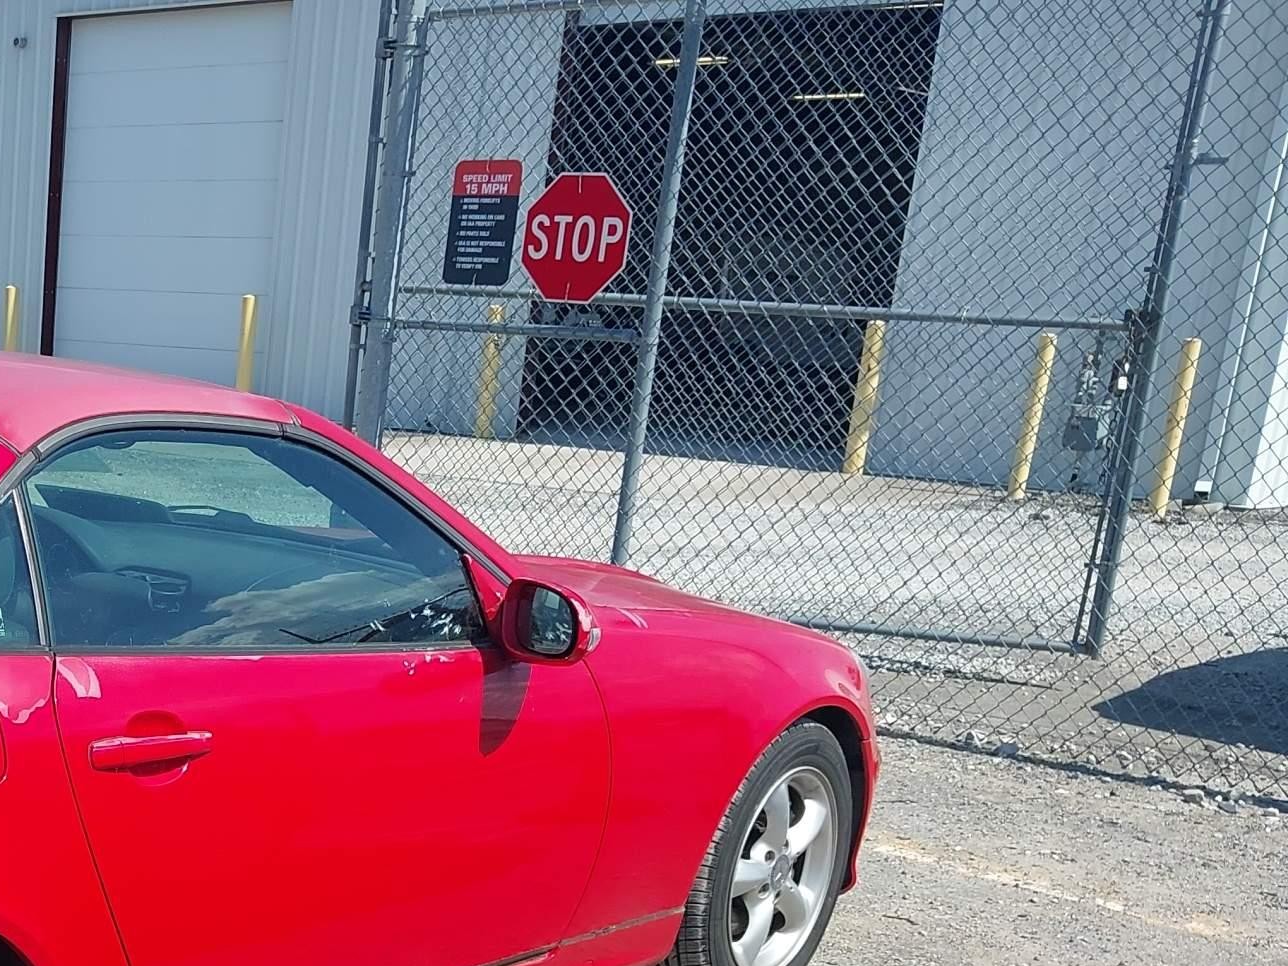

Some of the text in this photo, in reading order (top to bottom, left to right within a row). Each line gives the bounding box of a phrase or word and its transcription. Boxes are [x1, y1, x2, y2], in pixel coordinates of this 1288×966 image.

[462, 174, 513, 183] SPEED LIMIT
[465, 183, 508, 195] 15 MPH
[527, 214, 624, 263] STOP
